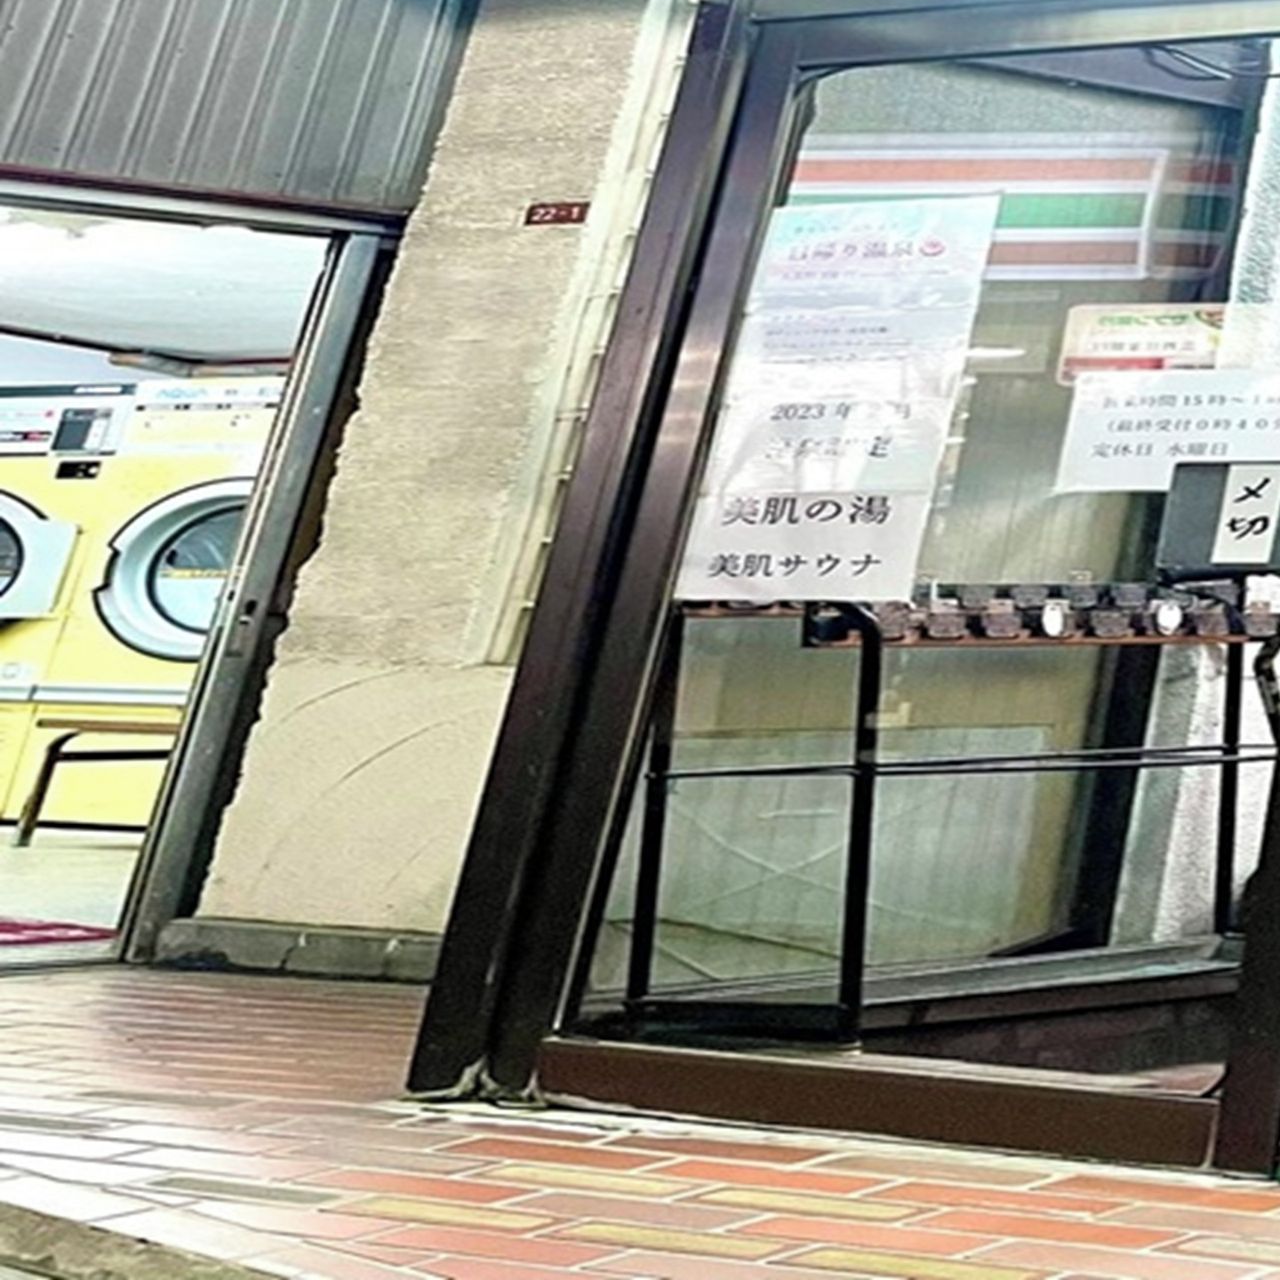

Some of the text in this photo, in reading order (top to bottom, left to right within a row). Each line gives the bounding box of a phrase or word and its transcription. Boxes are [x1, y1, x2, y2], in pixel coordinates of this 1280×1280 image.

[531, 206, 580, 221] 22-1
[720, 494, 892, 526] 美肌の湯
[708, 552, 883, 578] 美肌サウナ
